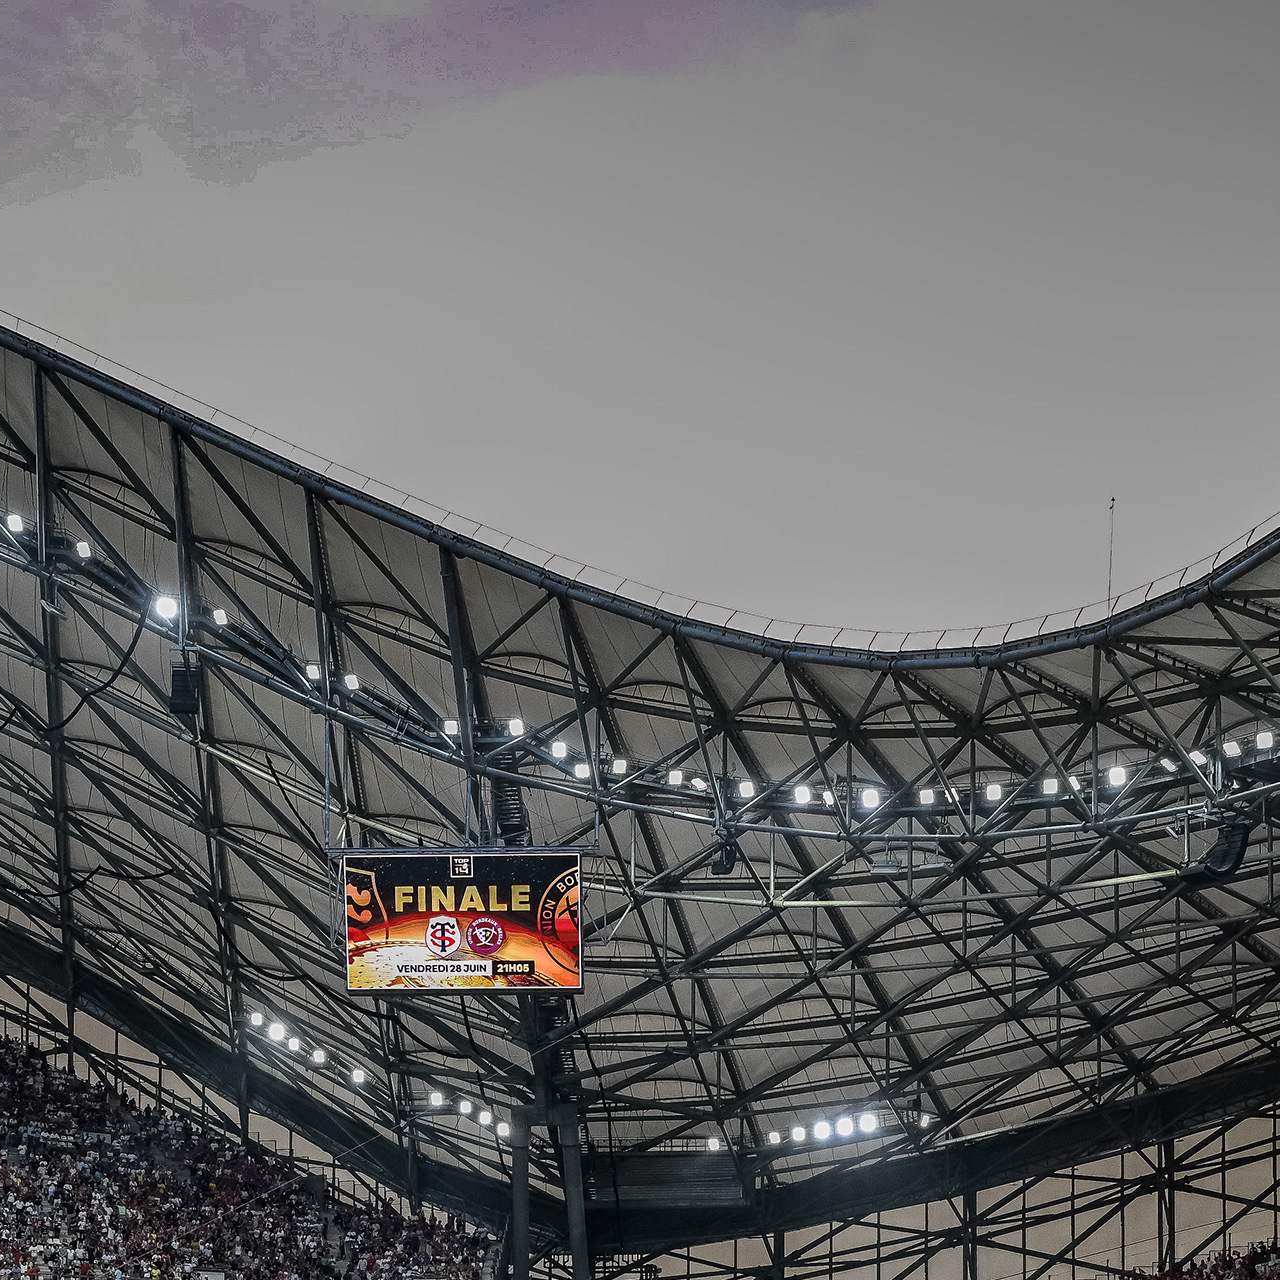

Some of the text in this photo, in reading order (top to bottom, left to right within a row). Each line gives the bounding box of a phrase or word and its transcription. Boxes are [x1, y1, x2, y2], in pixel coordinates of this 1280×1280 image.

[454, 866, 469, 875] 14
[394, 885, 531, 912] FINALE
[397, 964, 487, 973] VENDREDI 28 JUIN
[497, 963, 529, 973] 21H05
